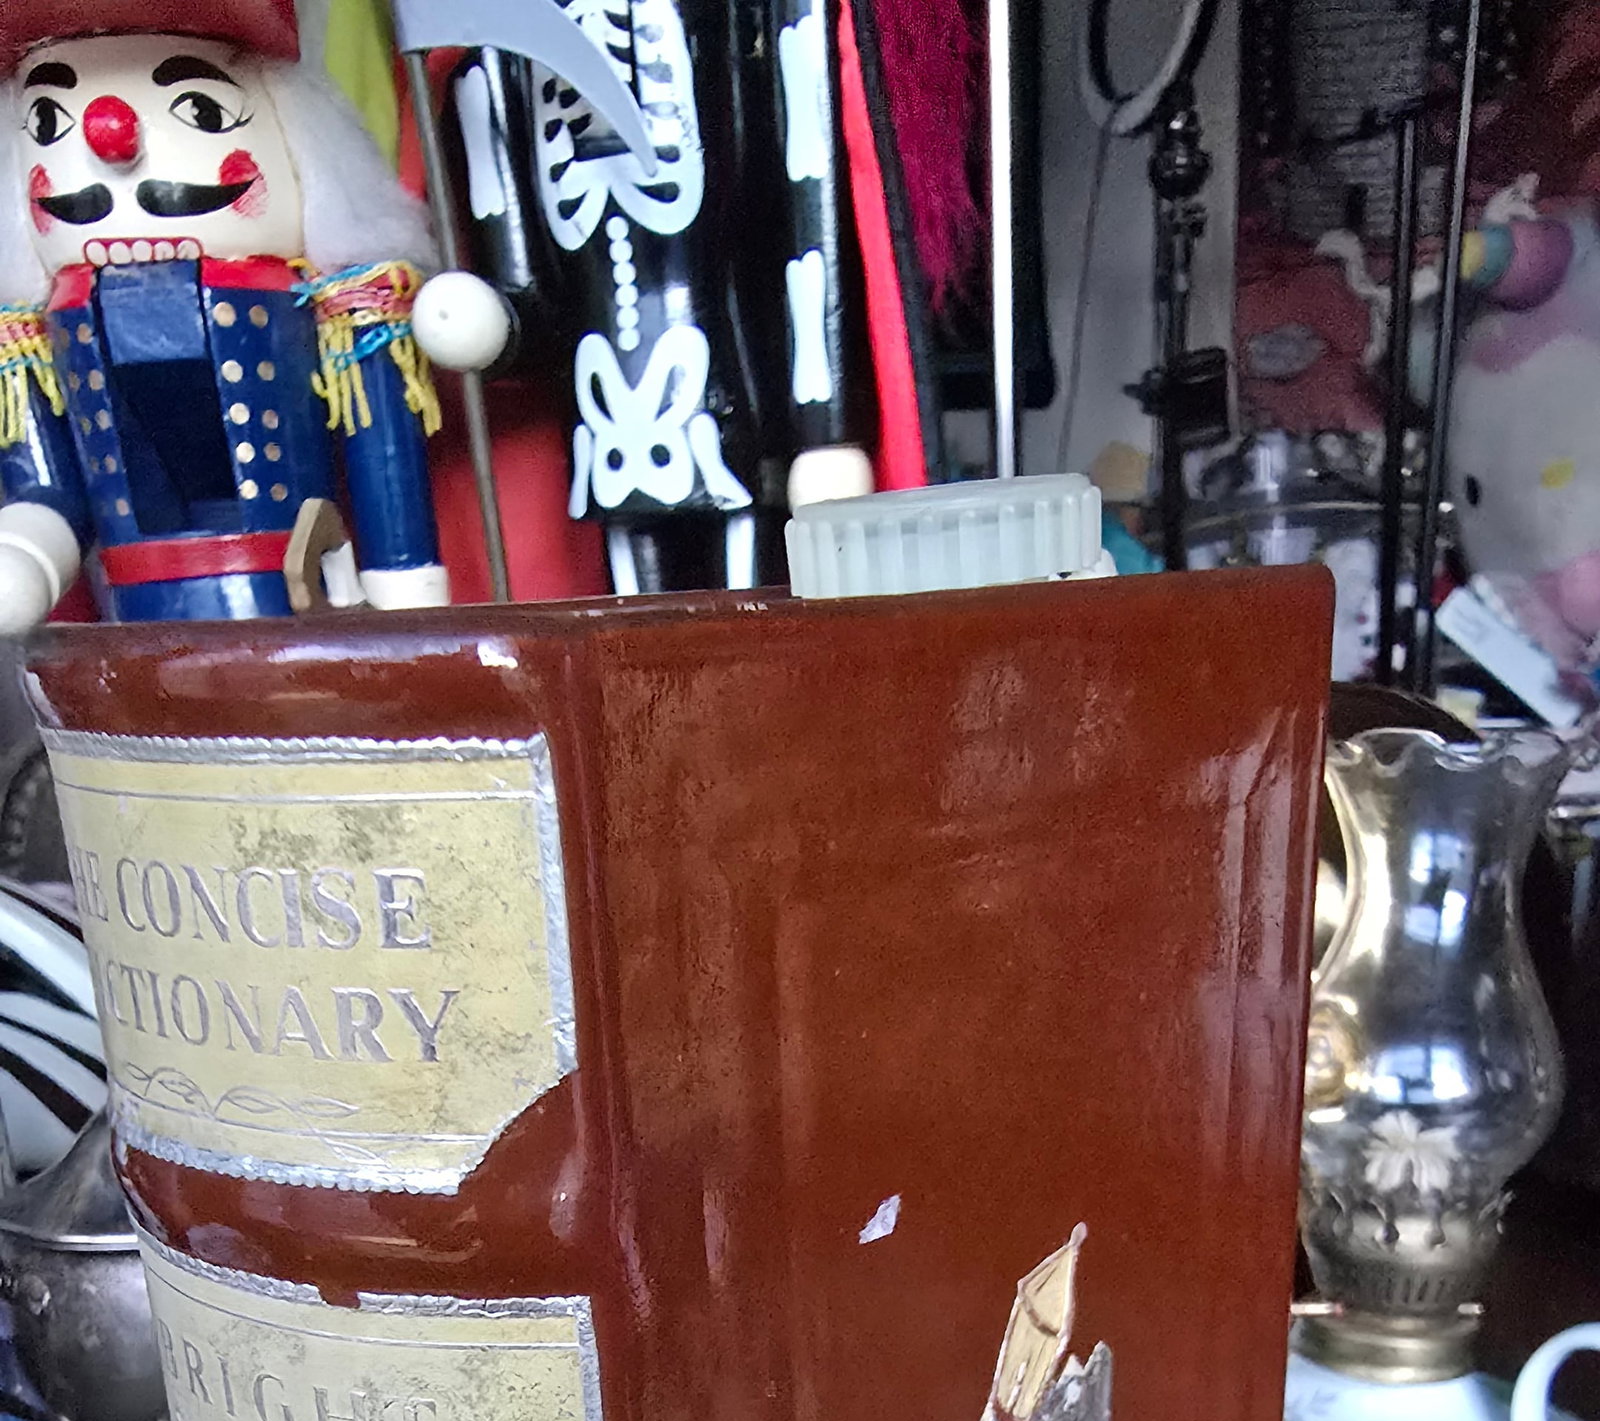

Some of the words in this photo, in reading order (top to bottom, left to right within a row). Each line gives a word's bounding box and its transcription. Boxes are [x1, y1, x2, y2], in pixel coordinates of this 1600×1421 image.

[74, 848, 109, 922] HE
[116, 857, 432, 951] CONCISE
[98, 955, 460, 1064] CTIONARY
